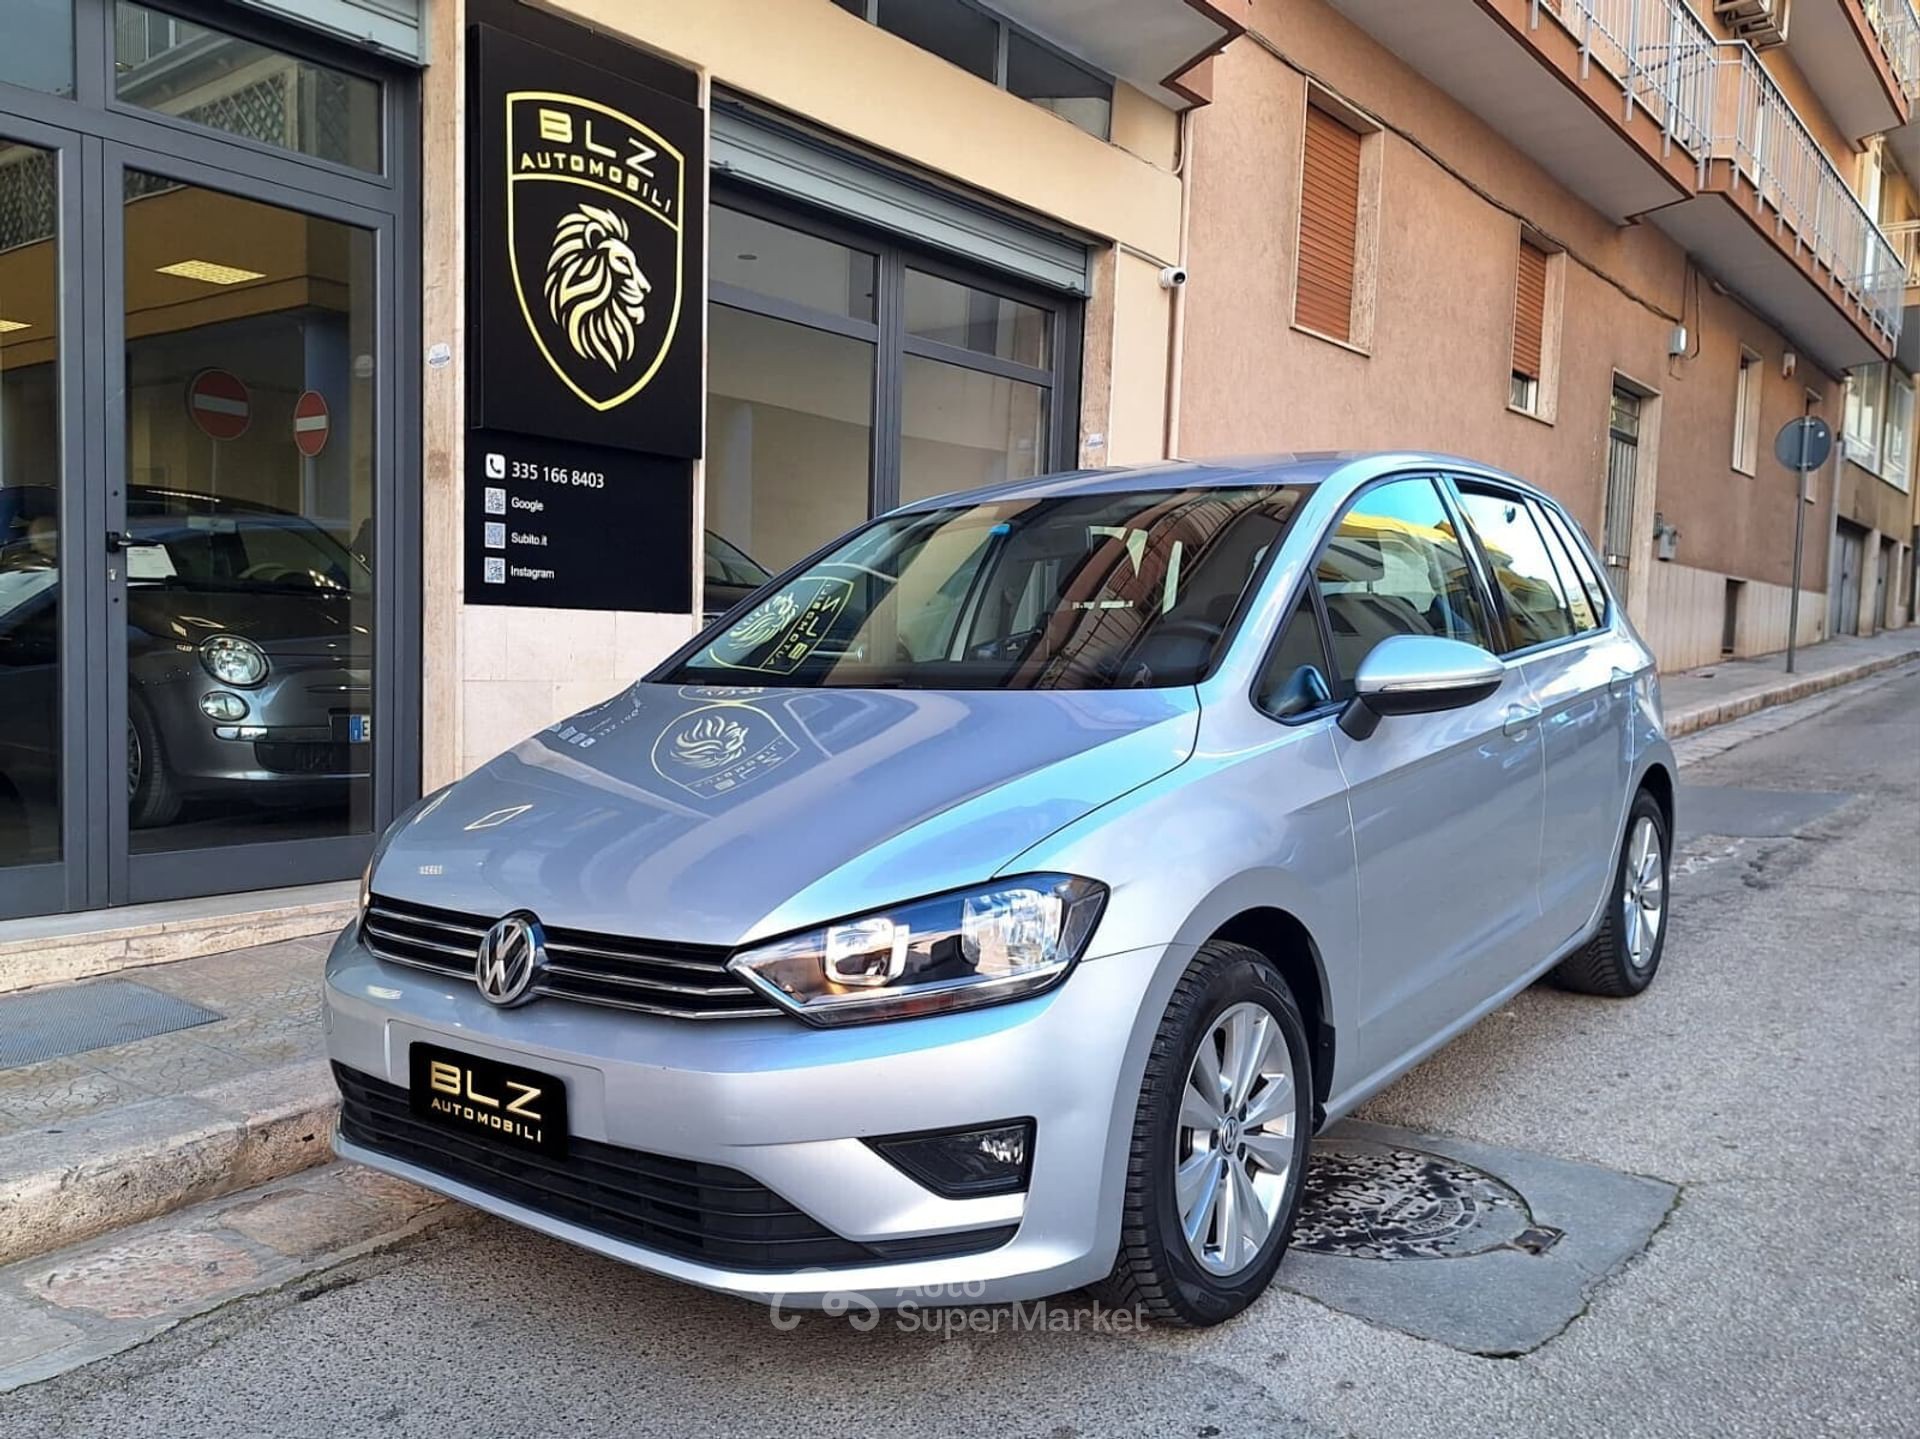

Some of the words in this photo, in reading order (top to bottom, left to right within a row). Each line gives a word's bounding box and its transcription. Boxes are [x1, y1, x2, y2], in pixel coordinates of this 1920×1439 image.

[539, 108, 657, 177] BLZ
[521, 152, 672, 213] AUTOMOBILI
[511, 461, 538, 480] 335
[543, 466, 568, 484] 166
[572, 470, 605, 488] 8403
[511, 497, 544, 512] Google
[510, 565, 555, 580] Instagram
[430, 1060, 541, 1119] BLZ
[431, 1097, 542, 1143] AUTOMOBILI
